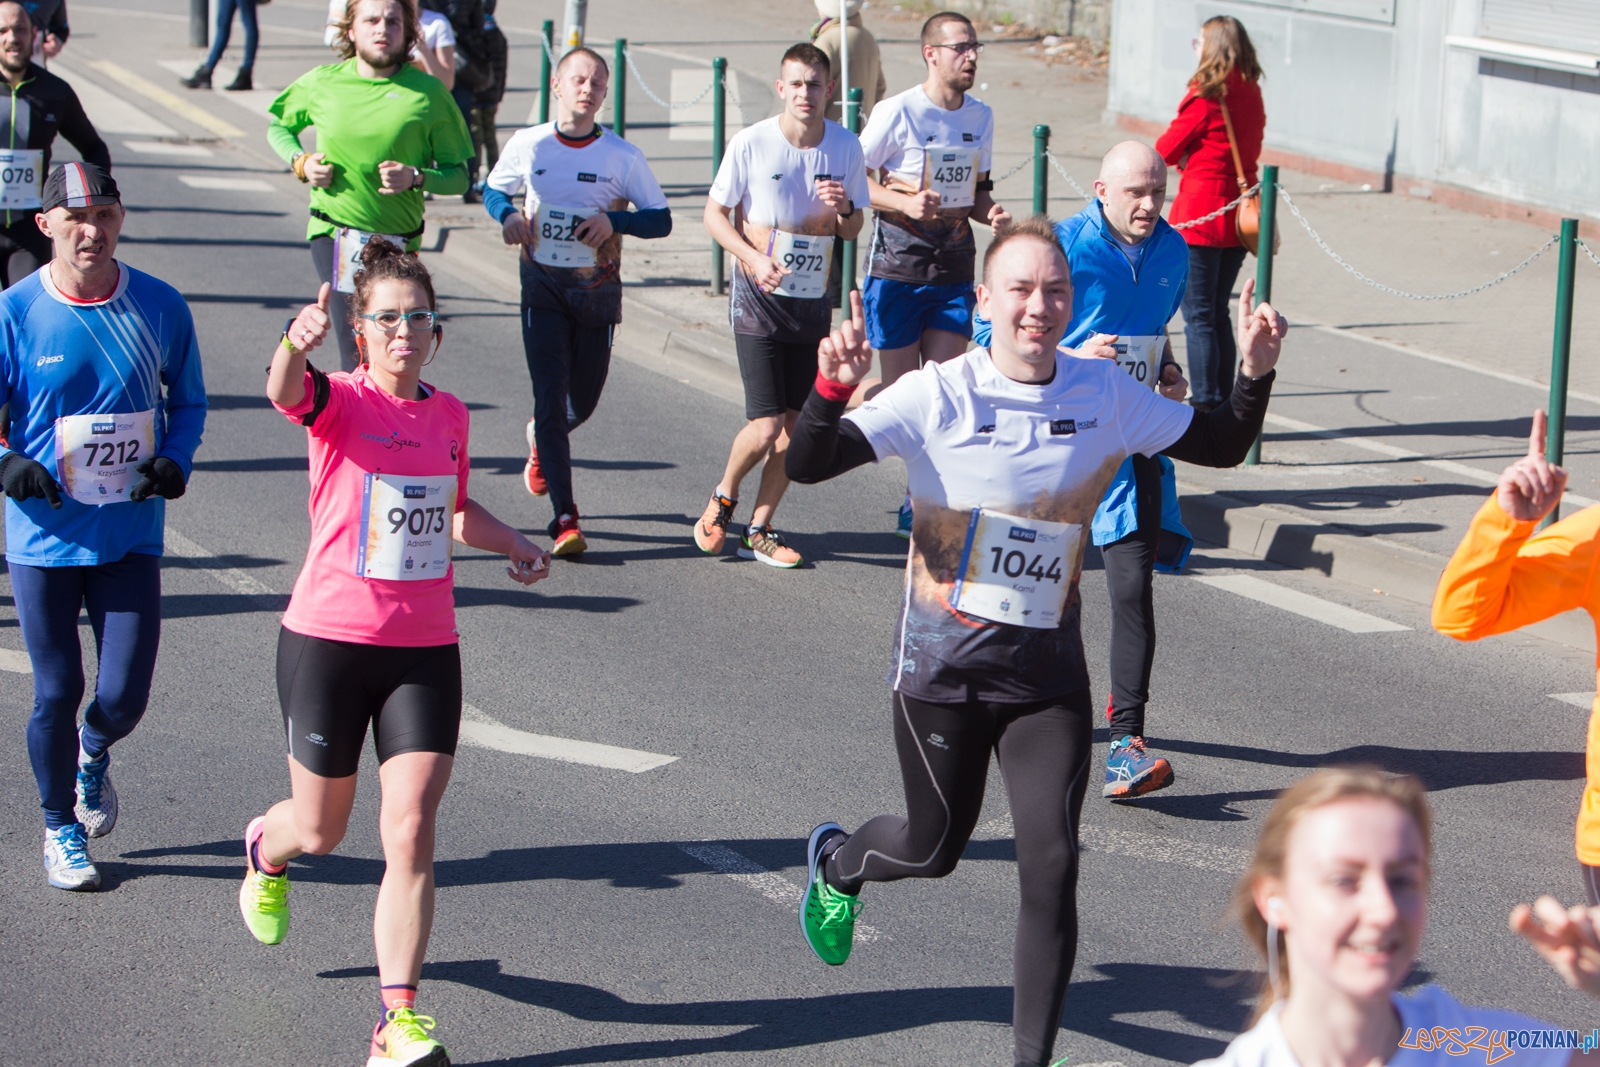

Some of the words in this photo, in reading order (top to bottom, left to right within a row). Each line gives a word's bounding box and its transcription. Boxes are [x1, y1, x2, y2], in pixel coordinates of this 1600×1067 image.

[934, 166, 972, 183] 4387
[541, 222, 580, 242] 822
[783, 253, 823, 272] 9972
[45, 354, 64, 364] asics
[1116, 361, 1147, 382] 70
[83, 439, 140, 467] 7212
[97, 467, 128, 478] Krzysztof
[387, 506, 446, 536] 9073
[991, 546, 1062, 584] 1044
[1012, 583, 1036, 594] Kamil
